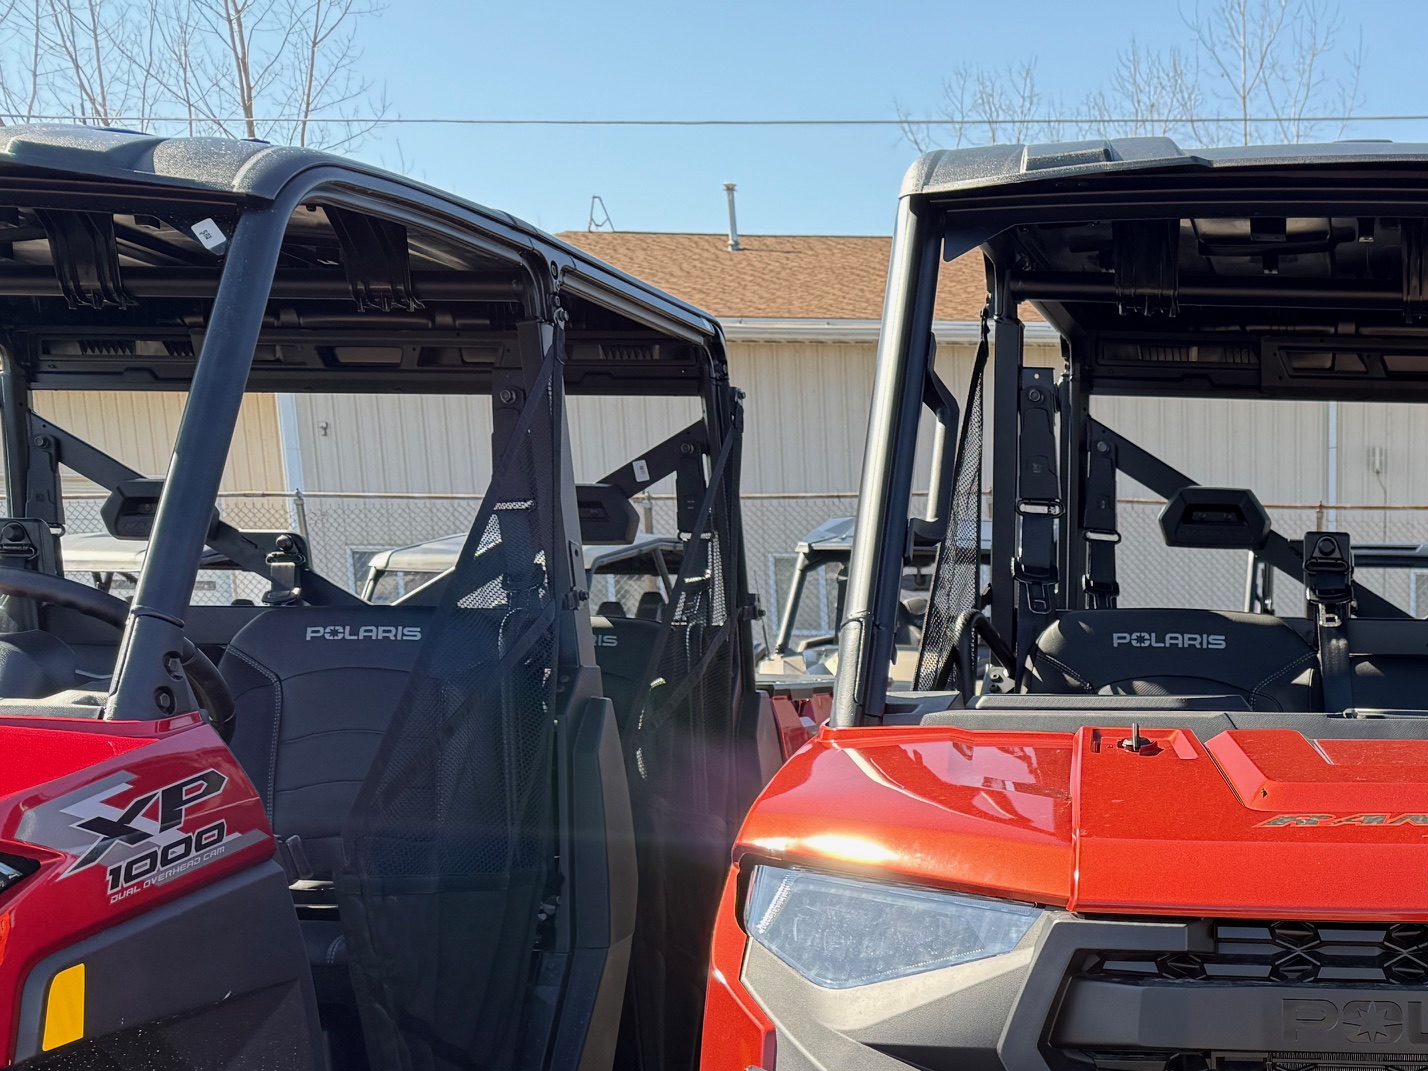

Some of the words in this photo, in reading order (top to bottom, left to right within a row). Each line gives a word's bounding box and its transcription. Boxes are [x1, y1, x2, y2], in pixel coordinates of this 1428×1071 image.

[306, 625, 421, 641] POLARIS
[1112, 631, 1226, 650] POLARIS
[63, 768, 229, 877] XP
[106, 819, 227, 895] 1000
[110, 885, 141, 904] DUAL
[143, 855, 201, 889] OVERHEAD
[203, 845, 225, 861] CAM
